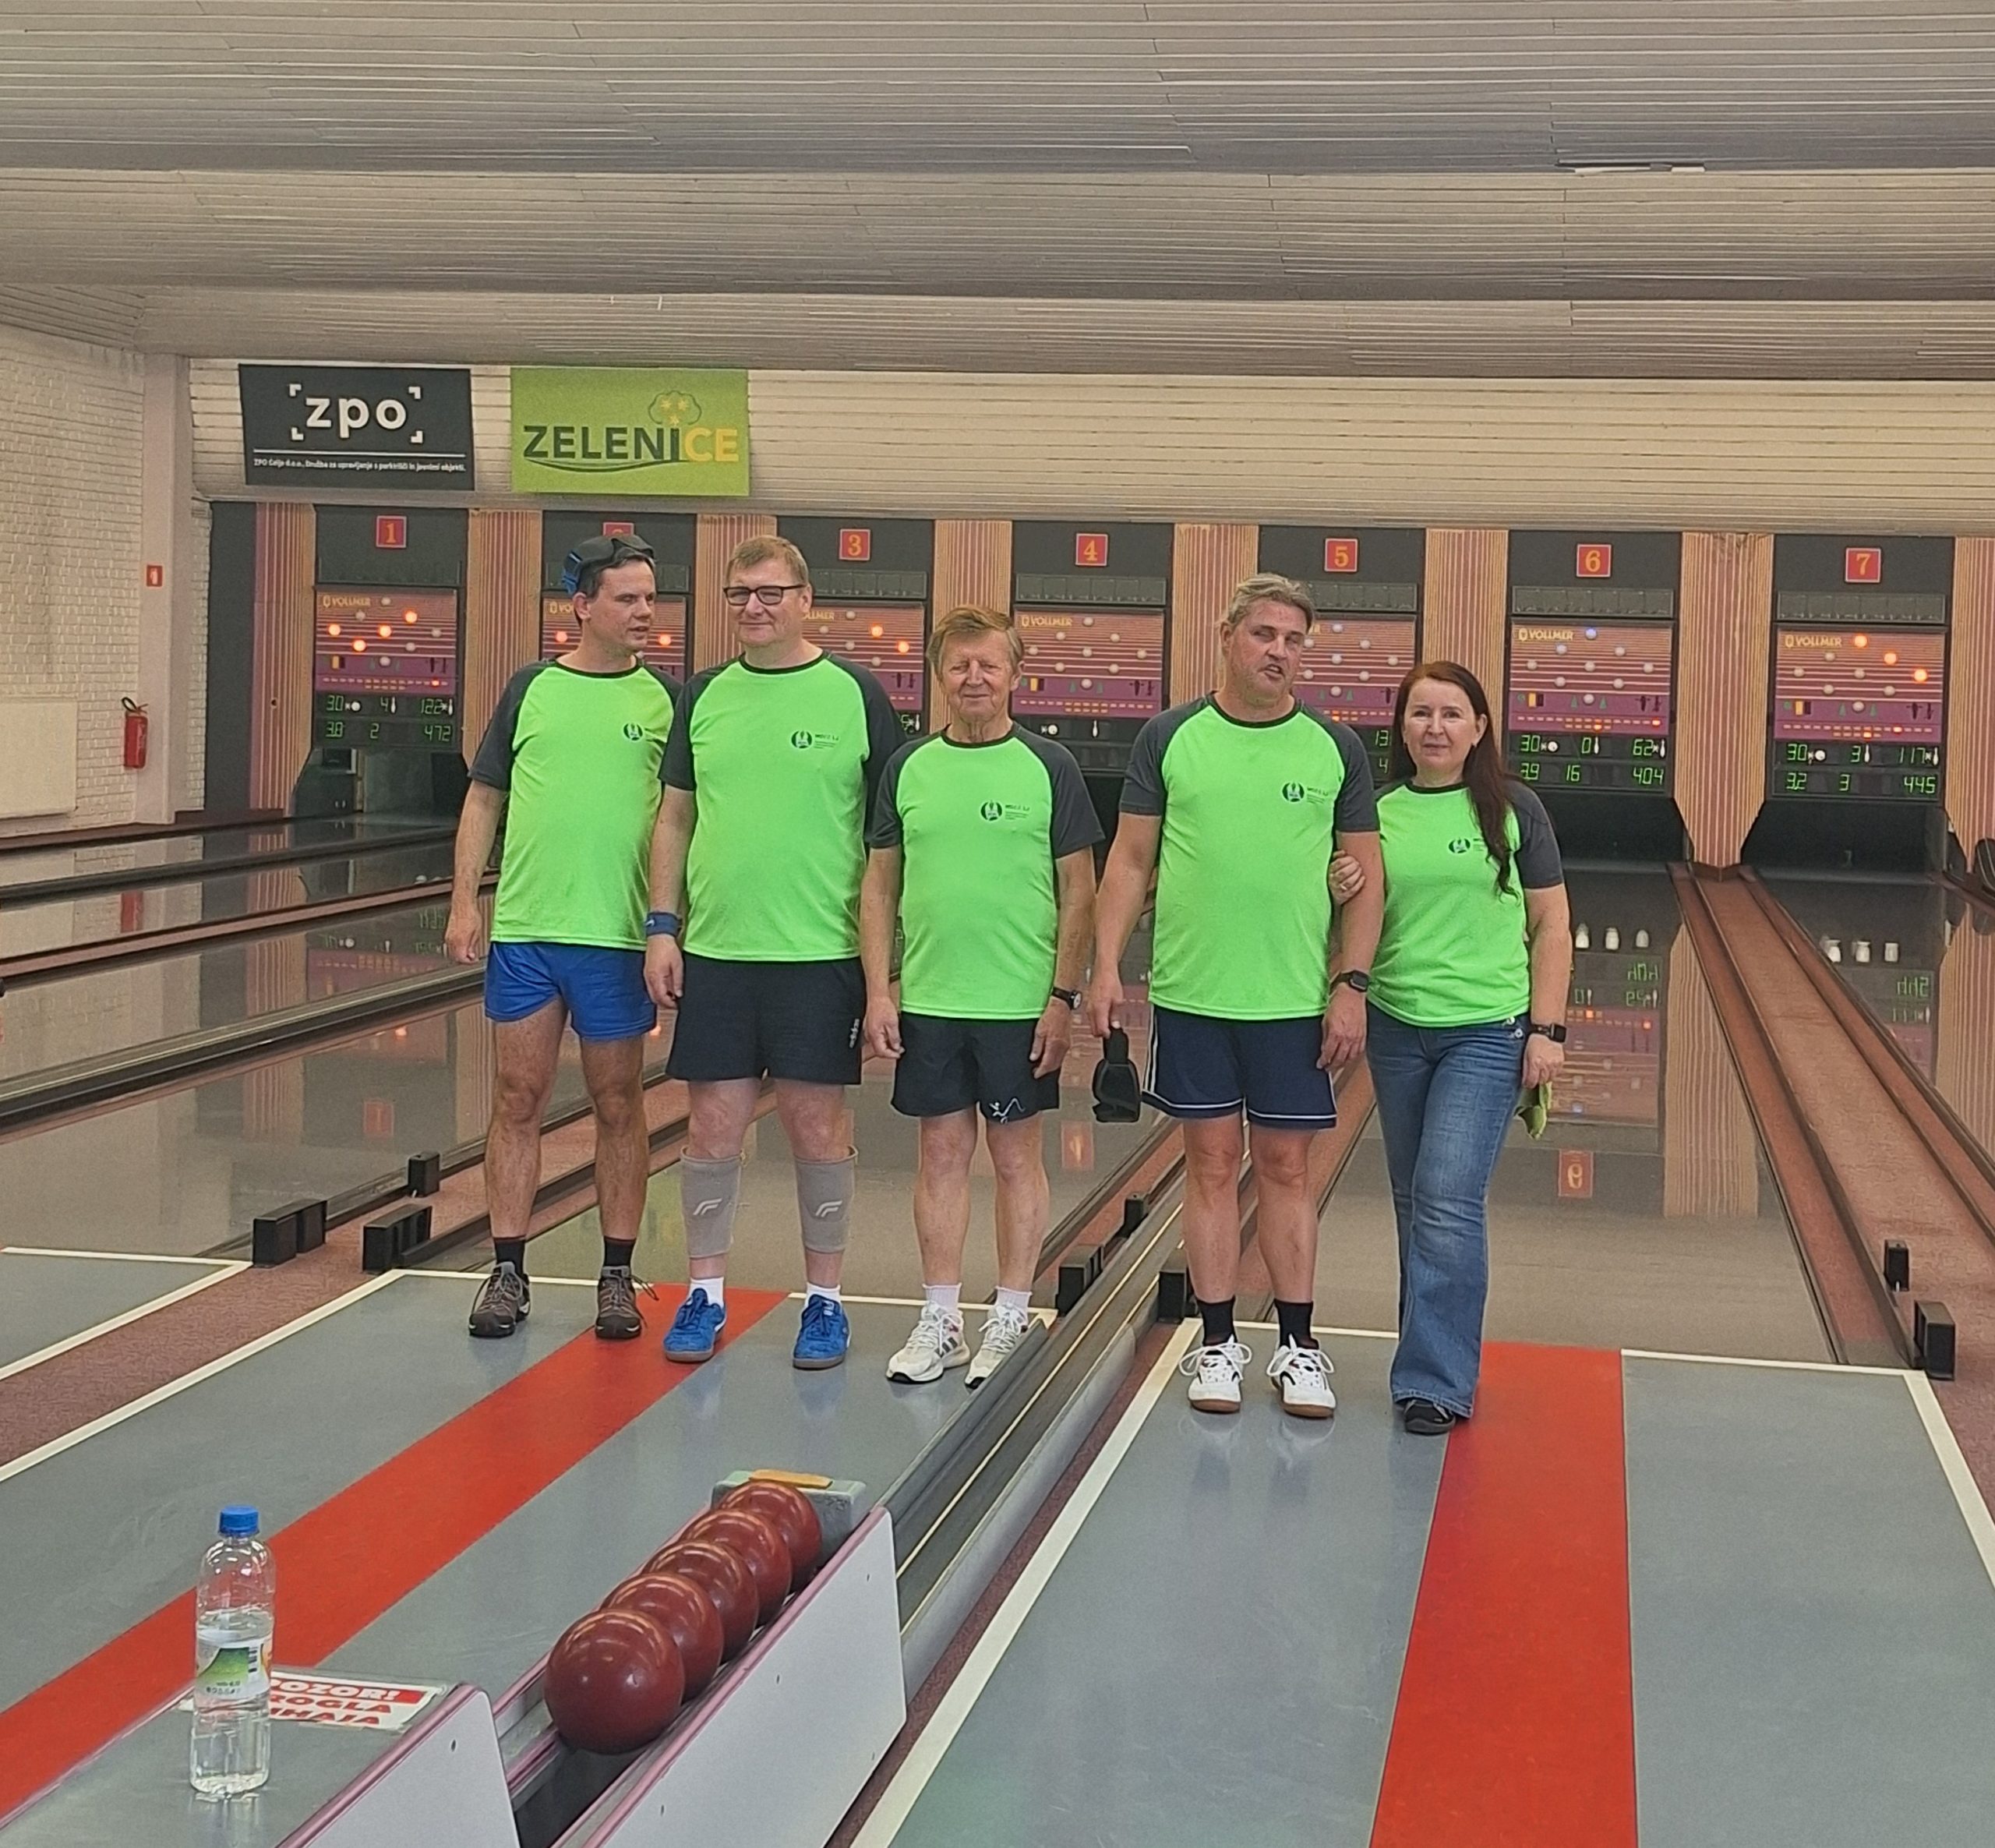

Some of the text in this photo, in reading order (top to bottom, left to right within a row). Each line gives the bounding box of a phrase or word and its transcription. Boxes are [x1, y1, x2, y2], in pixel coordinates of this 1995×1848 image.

[305, 398, 406, 438] zpo
[524, 426, 740, 462] ZELENICE
[386, 523, 396, 543] 1
[848, 534, 862, 556] 3
[1083, 540, 1098, 561] 4
[1334, 546, 1349, 567] 5
[1585, 550, 1601, 572] 6
[1856, 553, 1871, 575] 7
[1529, 629, 1573, 641] VOLLMER
[1796, 635, 1842, 647] VOLLMER
[327, 695, 344, 712] 30
[380, 696, 389, 712] 4
[370, 723, 380, 739] 2
[424, 725, 451, 741] 472
[1520, 734, 1654, 757] 30 0 62
[1787, 743, 1926, 764] 30 3 117
[1566, 765, 1580, 782] 16
[1633, 766, 1665, 786] 404
[1839, 774, 1851, 791] 3
[1903, 776, 1937, 793] 445
[270, 1694, 391, 1714] ROGLA
[270, 1707, 380, 1725] IHAJA
